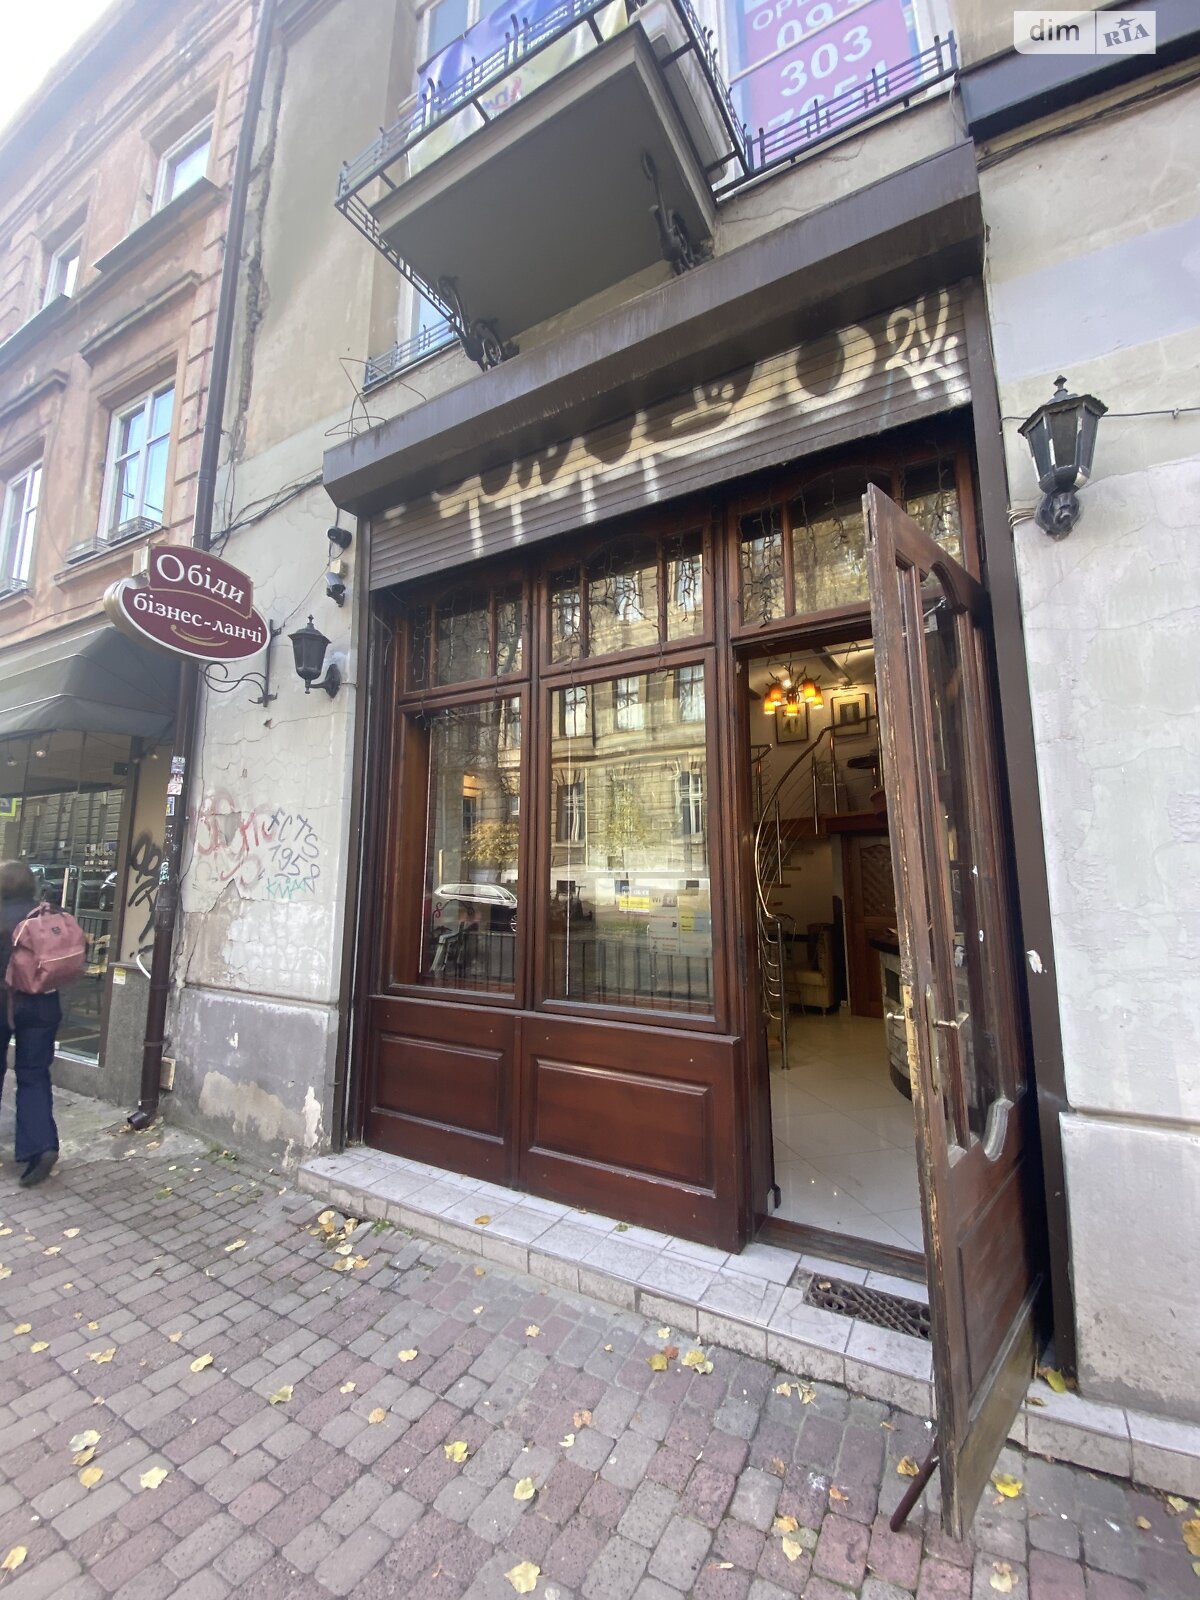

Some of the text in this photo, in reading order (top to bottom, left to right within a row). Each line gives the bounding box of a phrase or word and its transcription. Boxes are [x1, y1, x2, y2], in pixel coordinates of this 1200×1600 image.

[780, 25, 872, 97] 303
[156, 554, 245, 604] Обіди
[133, 593, 262, 643] бізнес-ланчі
